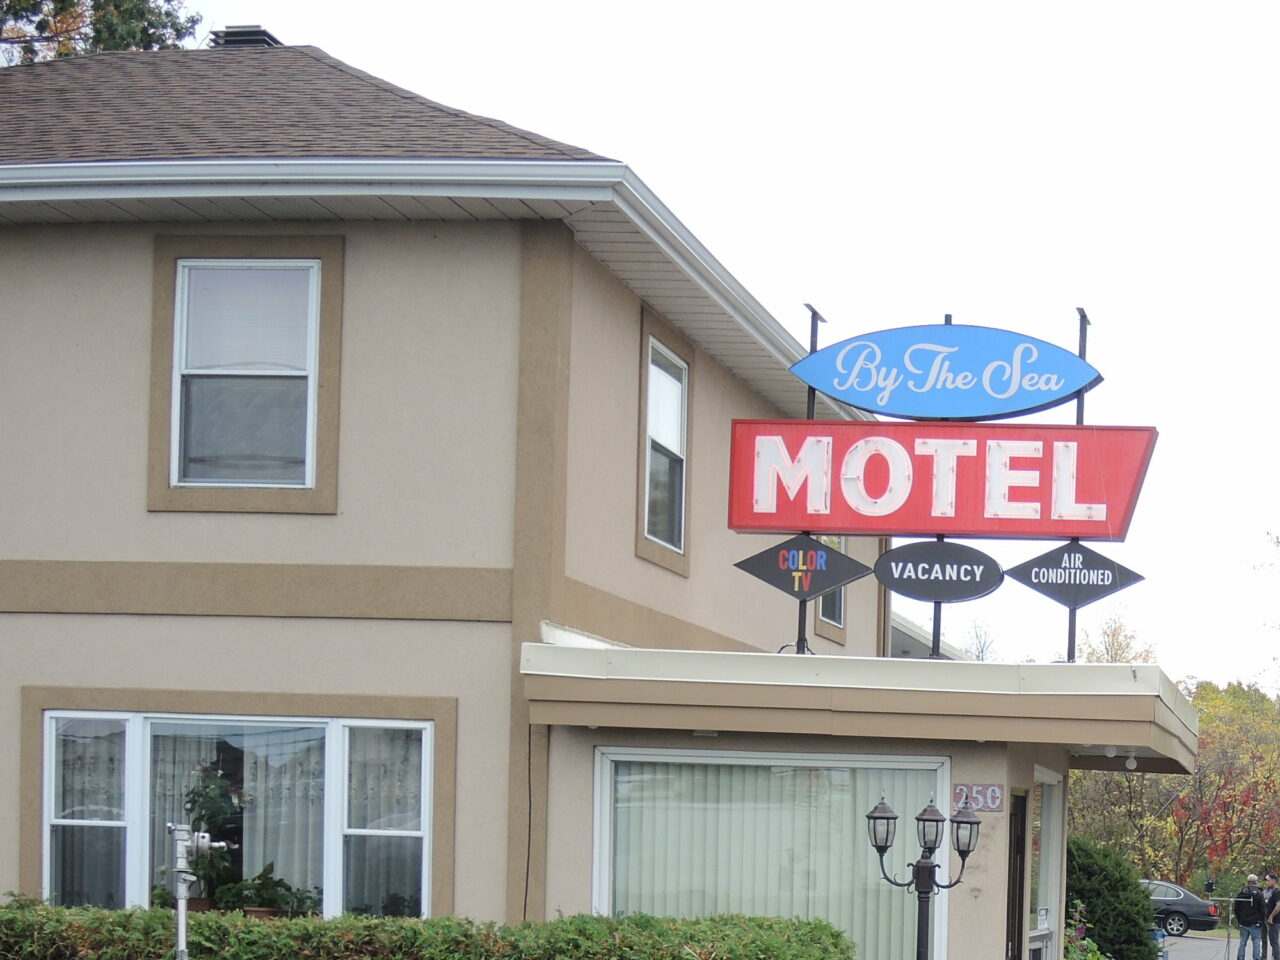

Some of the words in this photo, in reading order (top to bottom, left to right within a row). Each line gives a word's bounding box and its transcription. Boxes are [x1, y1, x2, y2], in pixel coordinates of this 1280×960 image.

[833, 341, 903, 406] By
[904, 343, 977, 393] The
[982, 343, 1064, 399] Sea
[753, 435, 1107, 520] MOTEL
[778, 550, 827, 571] COLOR
[1061, 553, 1083, 569] AIR
[792, 572, 812, 592] TV
[891, 562, 984, 582] VACANCY
[1031, 568, 1113, 585] CONDITIONED
[955, 785, 1001, 809] 250
